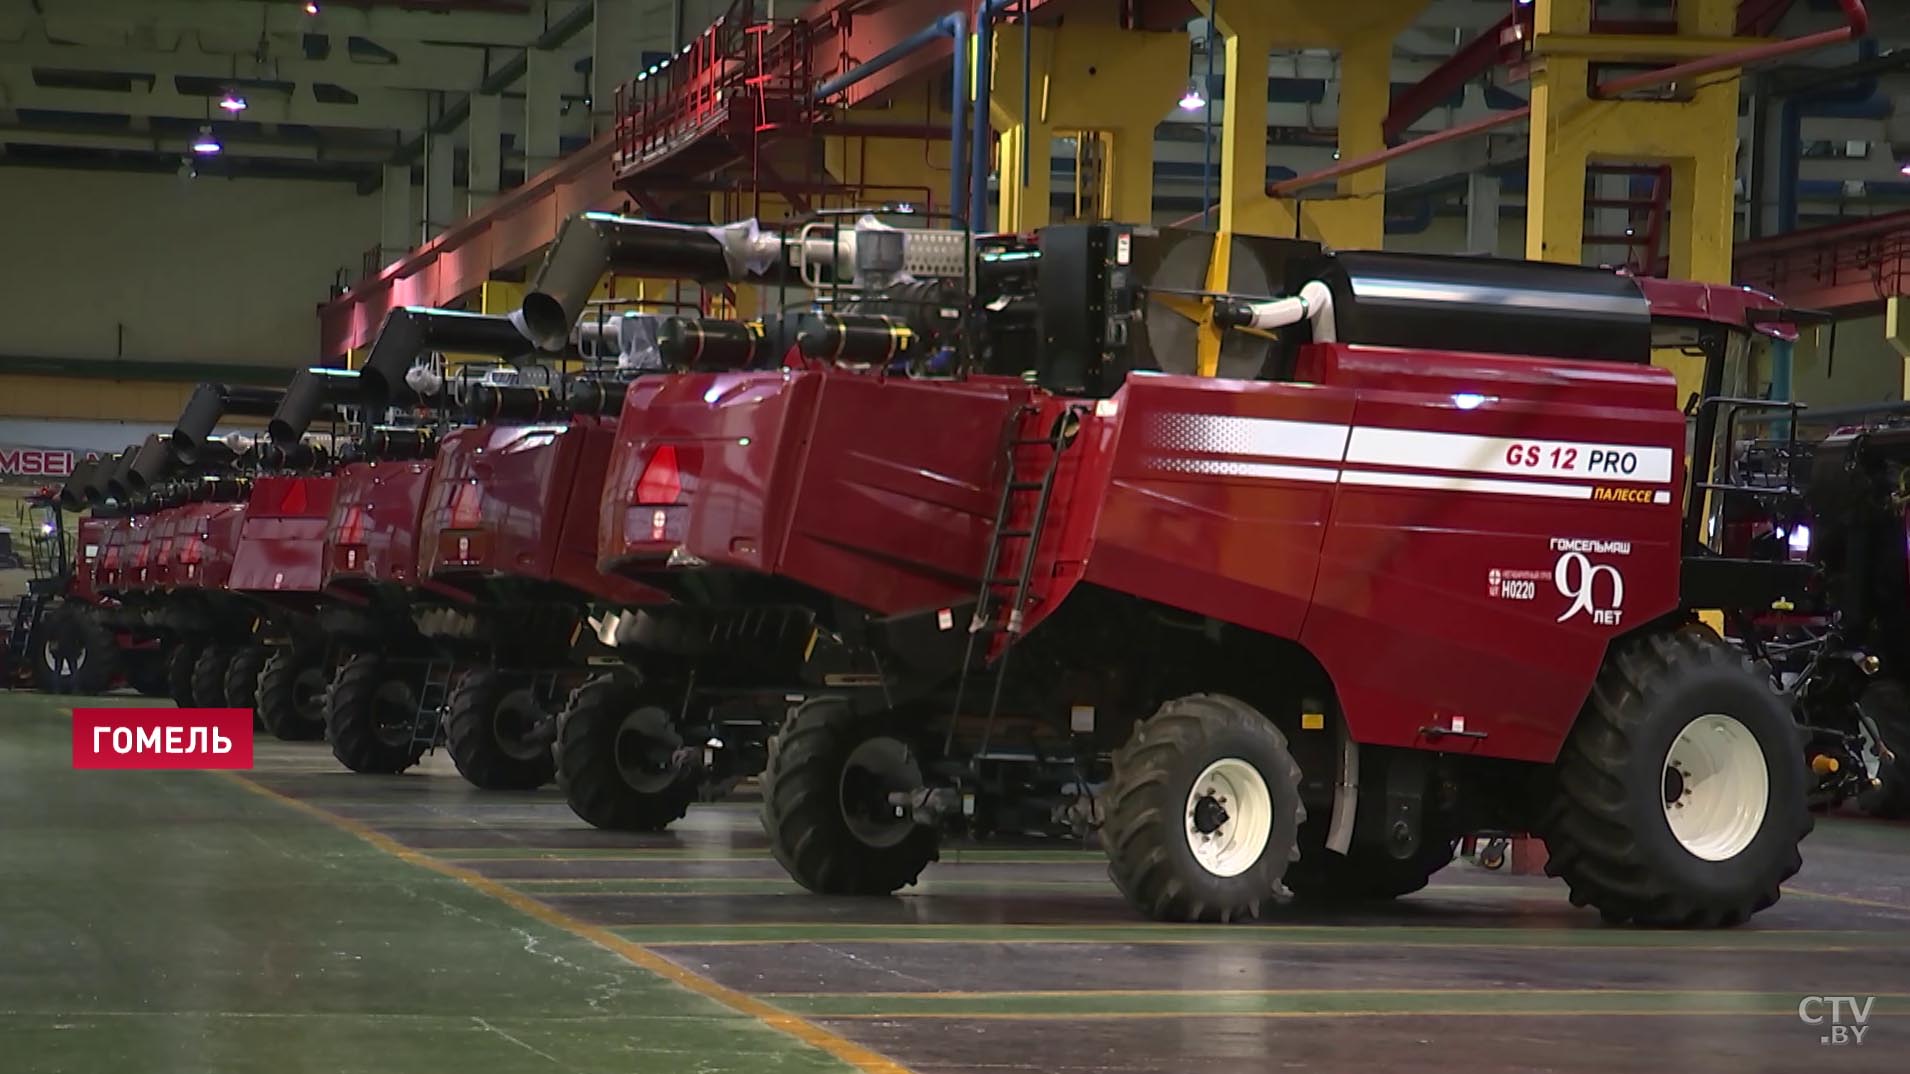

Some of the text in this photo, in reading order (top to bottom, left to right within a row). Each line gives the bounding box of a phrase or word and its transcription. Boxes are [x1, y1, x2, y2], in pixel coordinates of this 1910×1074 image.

[1506, 444, 1637, 475] GS 12 PRO
[1594, 487, 1652, 503] ПАЛЕССЕ
[1550, 538, 1631, 554] ГОМСЕЛЬМАШ
[1593, 610, 1622, 625] ЛЕТ
